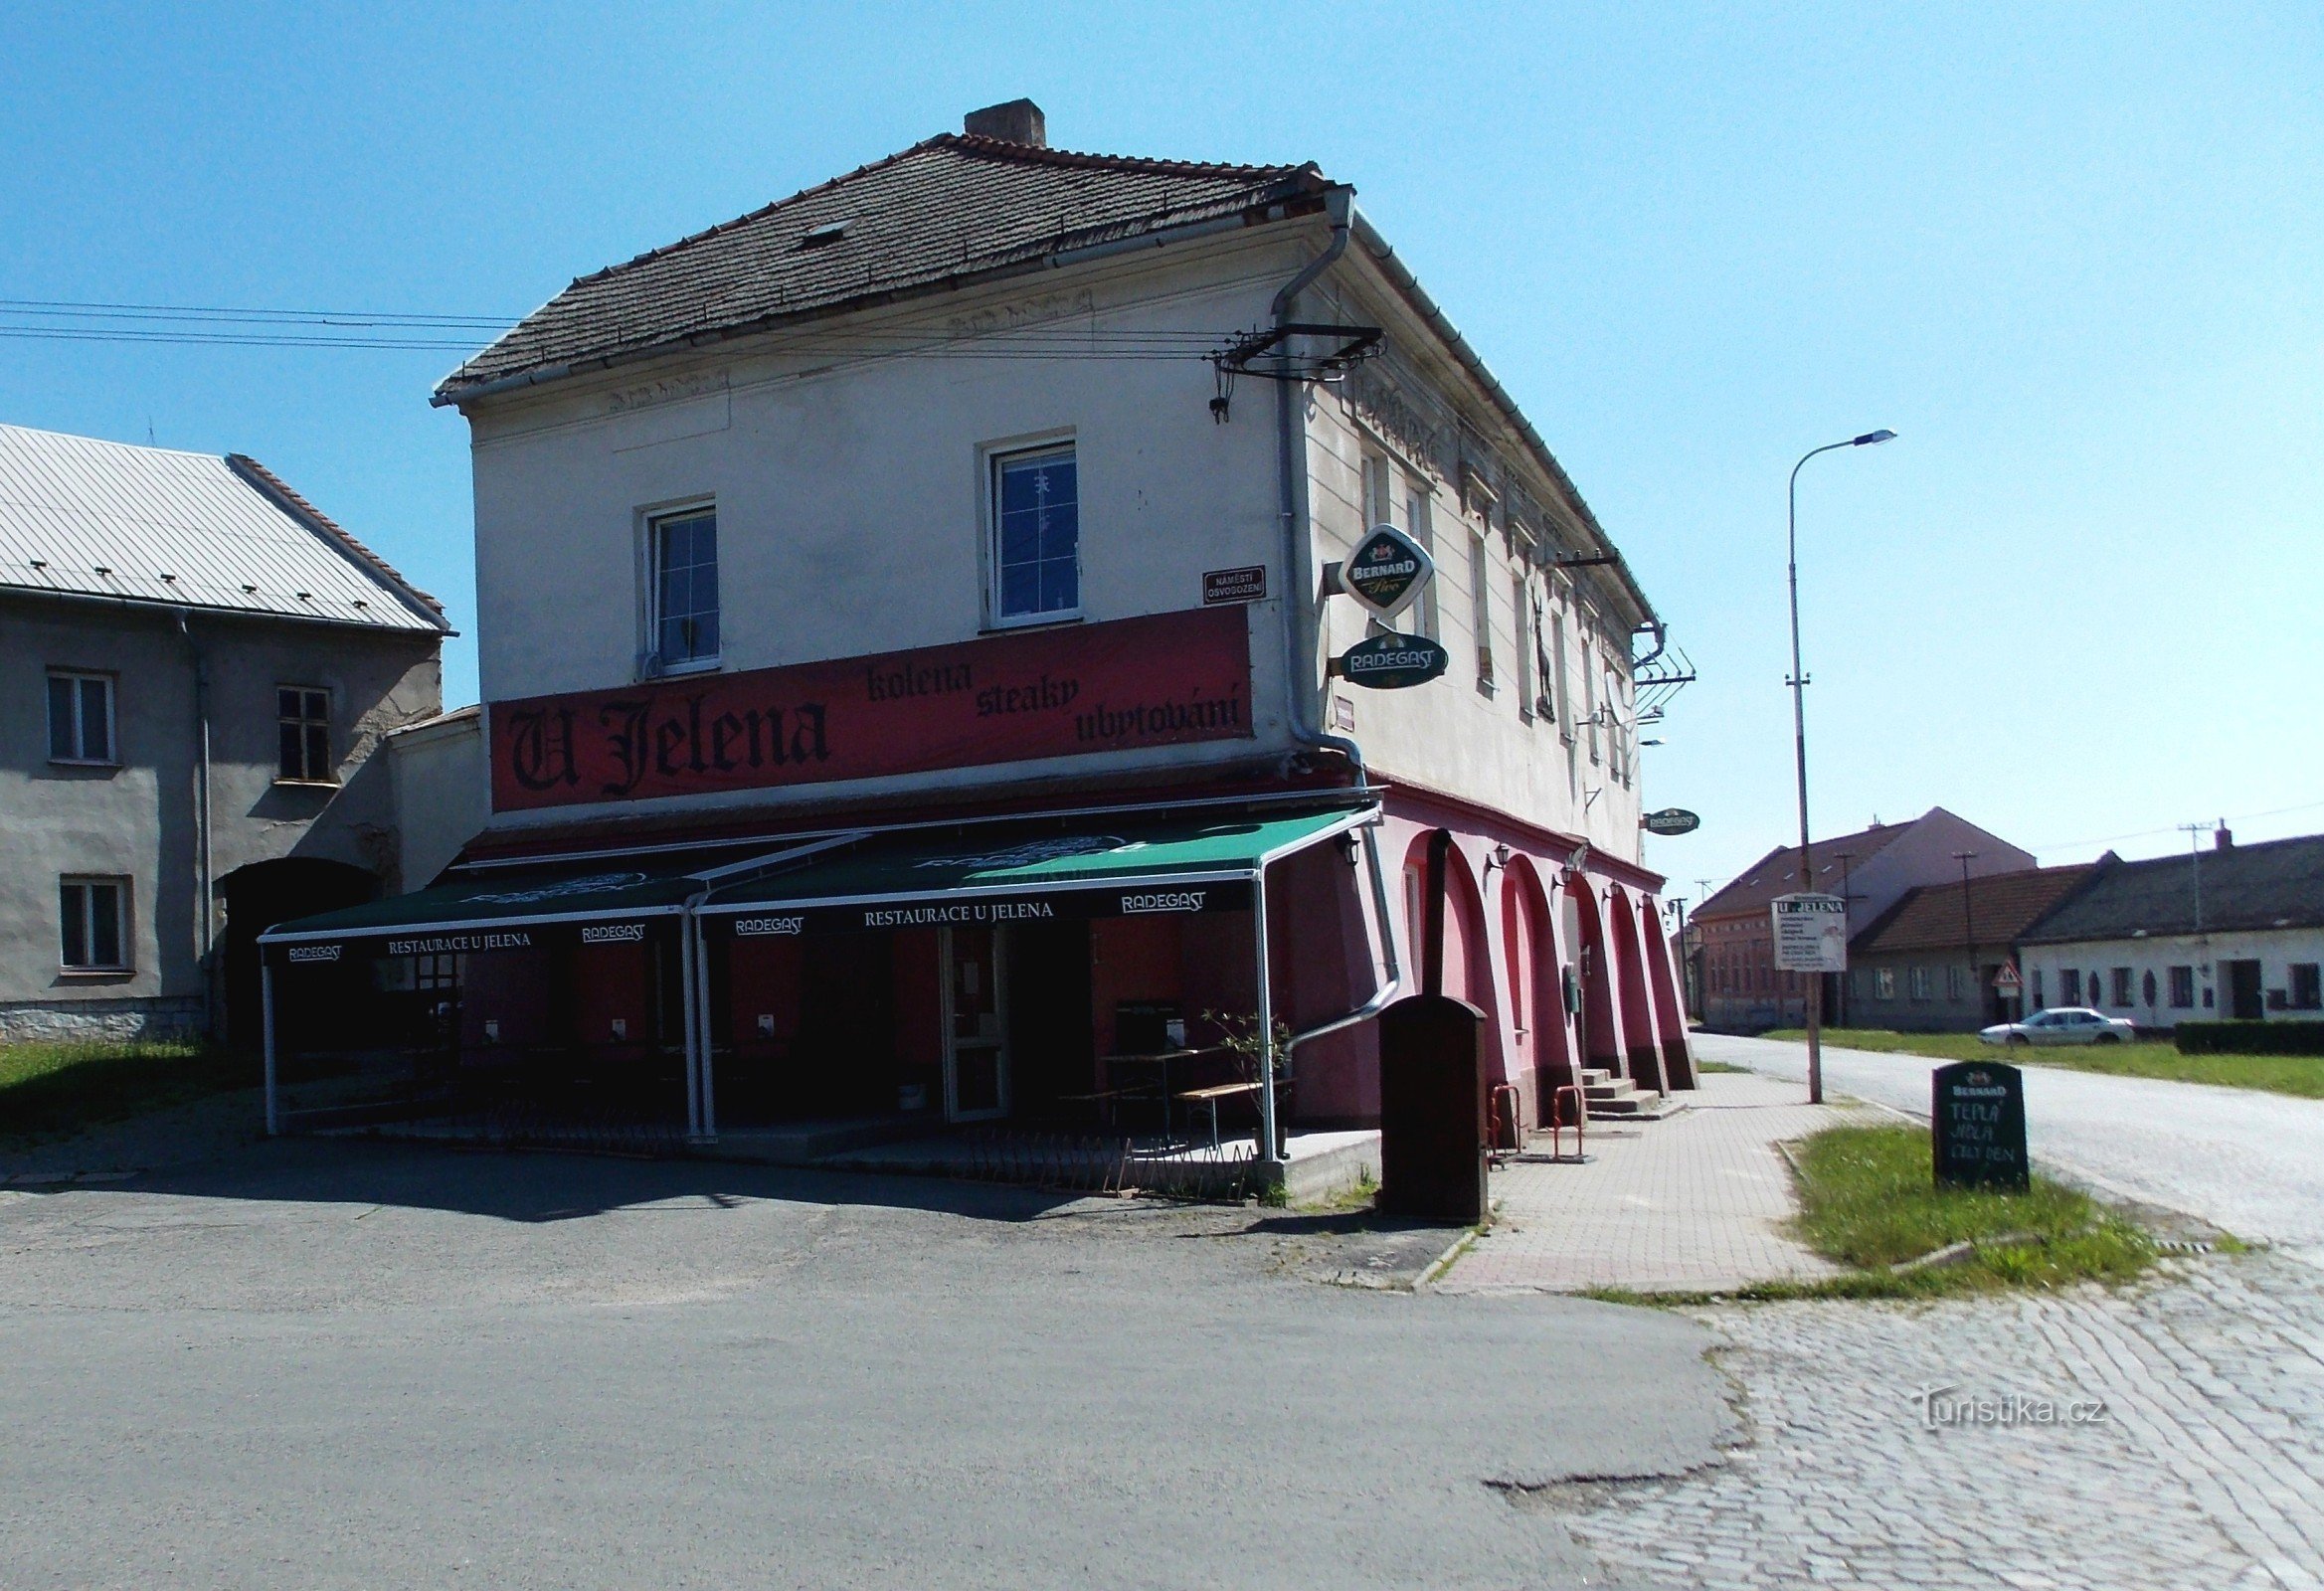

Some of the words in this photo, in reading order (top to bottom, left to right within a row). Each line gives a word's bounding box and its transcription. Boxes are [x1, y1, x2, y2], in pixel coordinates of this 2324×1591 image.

[1353, 560, 1415, 579] BERNARD
[1350, 650, 1435, 673] RADEGAST
[867, 662, 974, 702] kolena
[977, 674, 1079, 718] steaky
[1075, 683, 1241, 742] ubytování
[509, 708, 581, 791] U
[601, 693, 830, 796] Jelena
[1121, 892, 1207, 914] RADEGAST
[1778, 902, 1788, 913] U
[1798, 902, 1844, 913] JELENA
[864, 906, 971, 927] RESTAURACE
[974, 904, 987, 922] U
[990, 902, 1055, 923] JELENA
[582, 924, 646, 943] RADEGAST
[736, 917, 804, 936] RADEGAST
[288, 945, 342, 963] RADEGAST
[389, 937, 468, 955] RESTAURACE
[470, 936, 482, 950] U
[483, 933, 531, 951] JELENA
[1952, 1086, 2007, 1097] BERNARD
